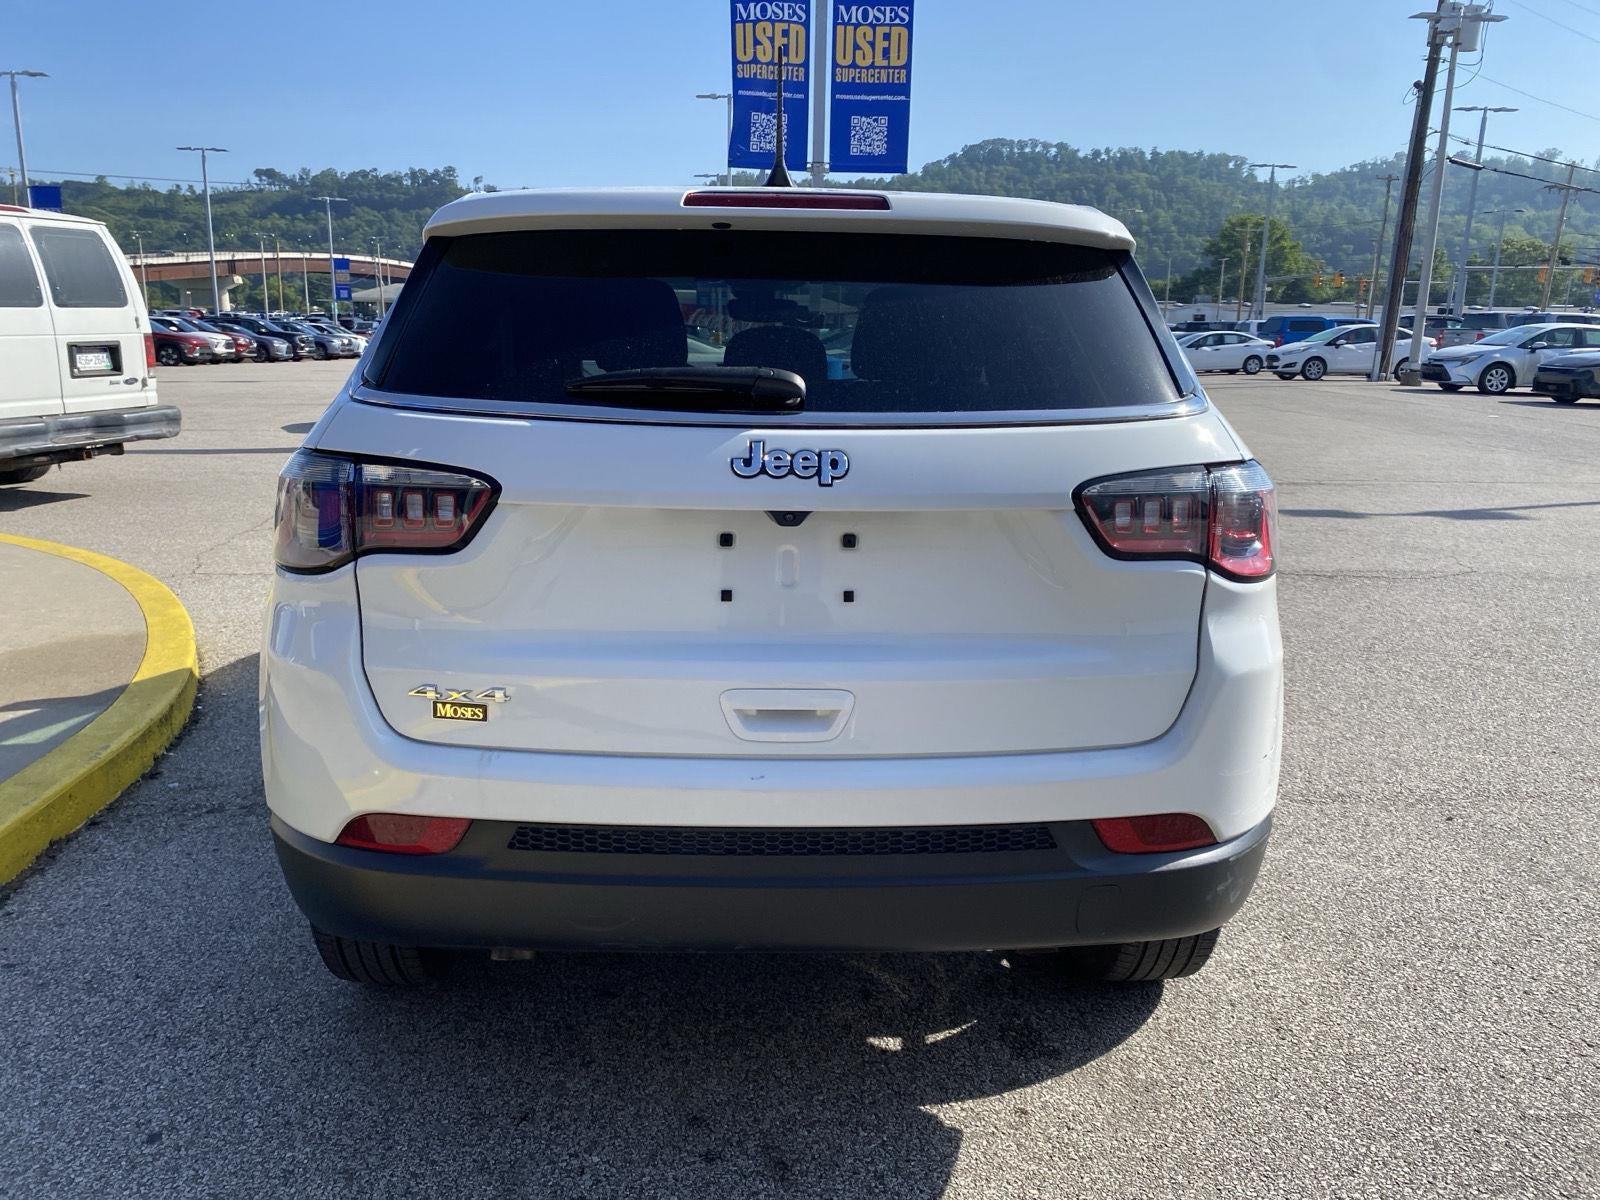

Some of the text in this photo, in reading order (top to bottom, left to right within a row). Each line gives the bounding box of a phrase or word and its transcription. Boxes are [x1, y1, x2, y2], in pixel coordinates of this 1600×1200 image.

[735, 2, 807, 23] MOSES
[837, 5, 909, 25] MOSES
[735, 21, 806, 64] USED
[835, 25, 908, 67] USED
[835, 67, 907, 84] SUPERCENTER
[730, 439, 850, 488] Jeep
